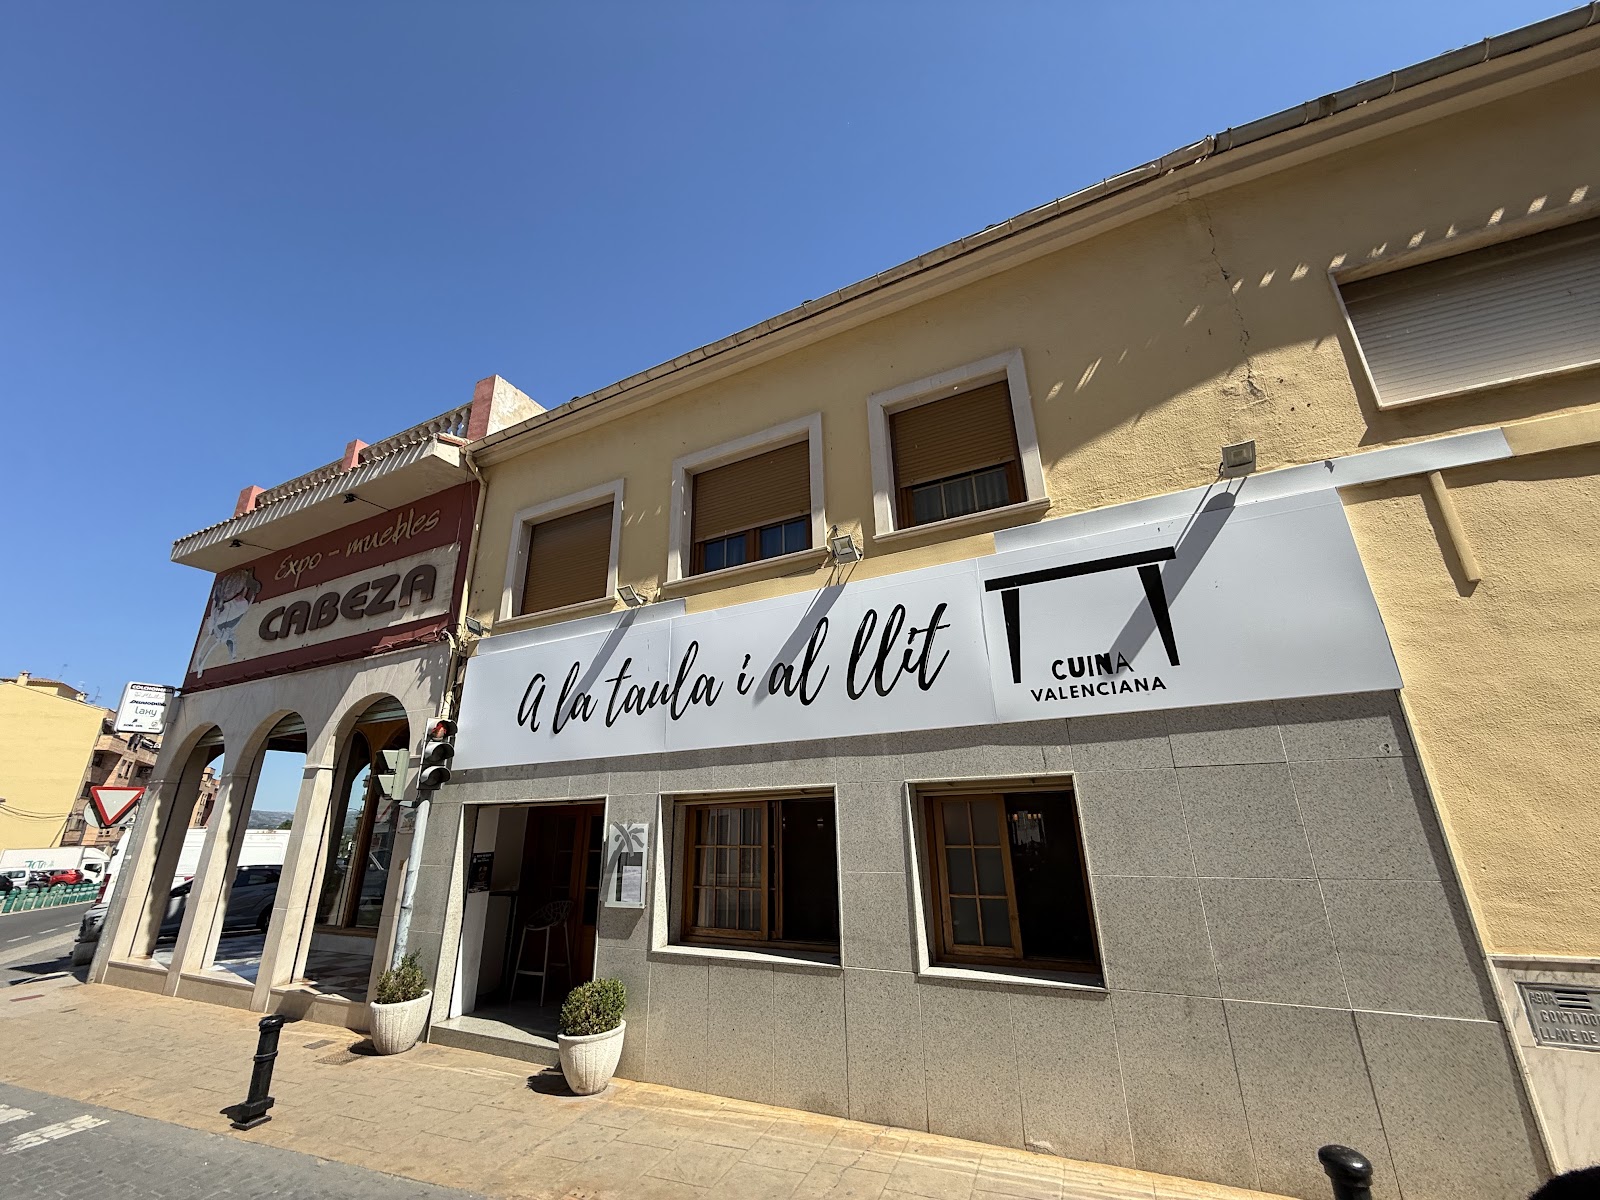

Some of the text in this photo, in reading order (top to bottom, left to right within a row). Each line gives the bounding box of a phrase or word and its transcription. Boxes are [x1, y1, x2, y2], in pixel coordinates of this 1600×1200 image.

[275, 554, 323, 588] Expo
[346, 508, 441, 558] muebles
[258, 564, 437, 641] CABEZA
[552, 661, 597, 735] la
[605, 640, 723, 728] taula
[736, 653, 755, 695] i
[768, 616, 830, 706] al
[847, 602, 951, 701] llit
[1030, 676, 1167, 702] VALENCIANA
[1051, 651, 1135, 680] CUINA
[1539, 1027, 1599, 1043] LLAVE DE
